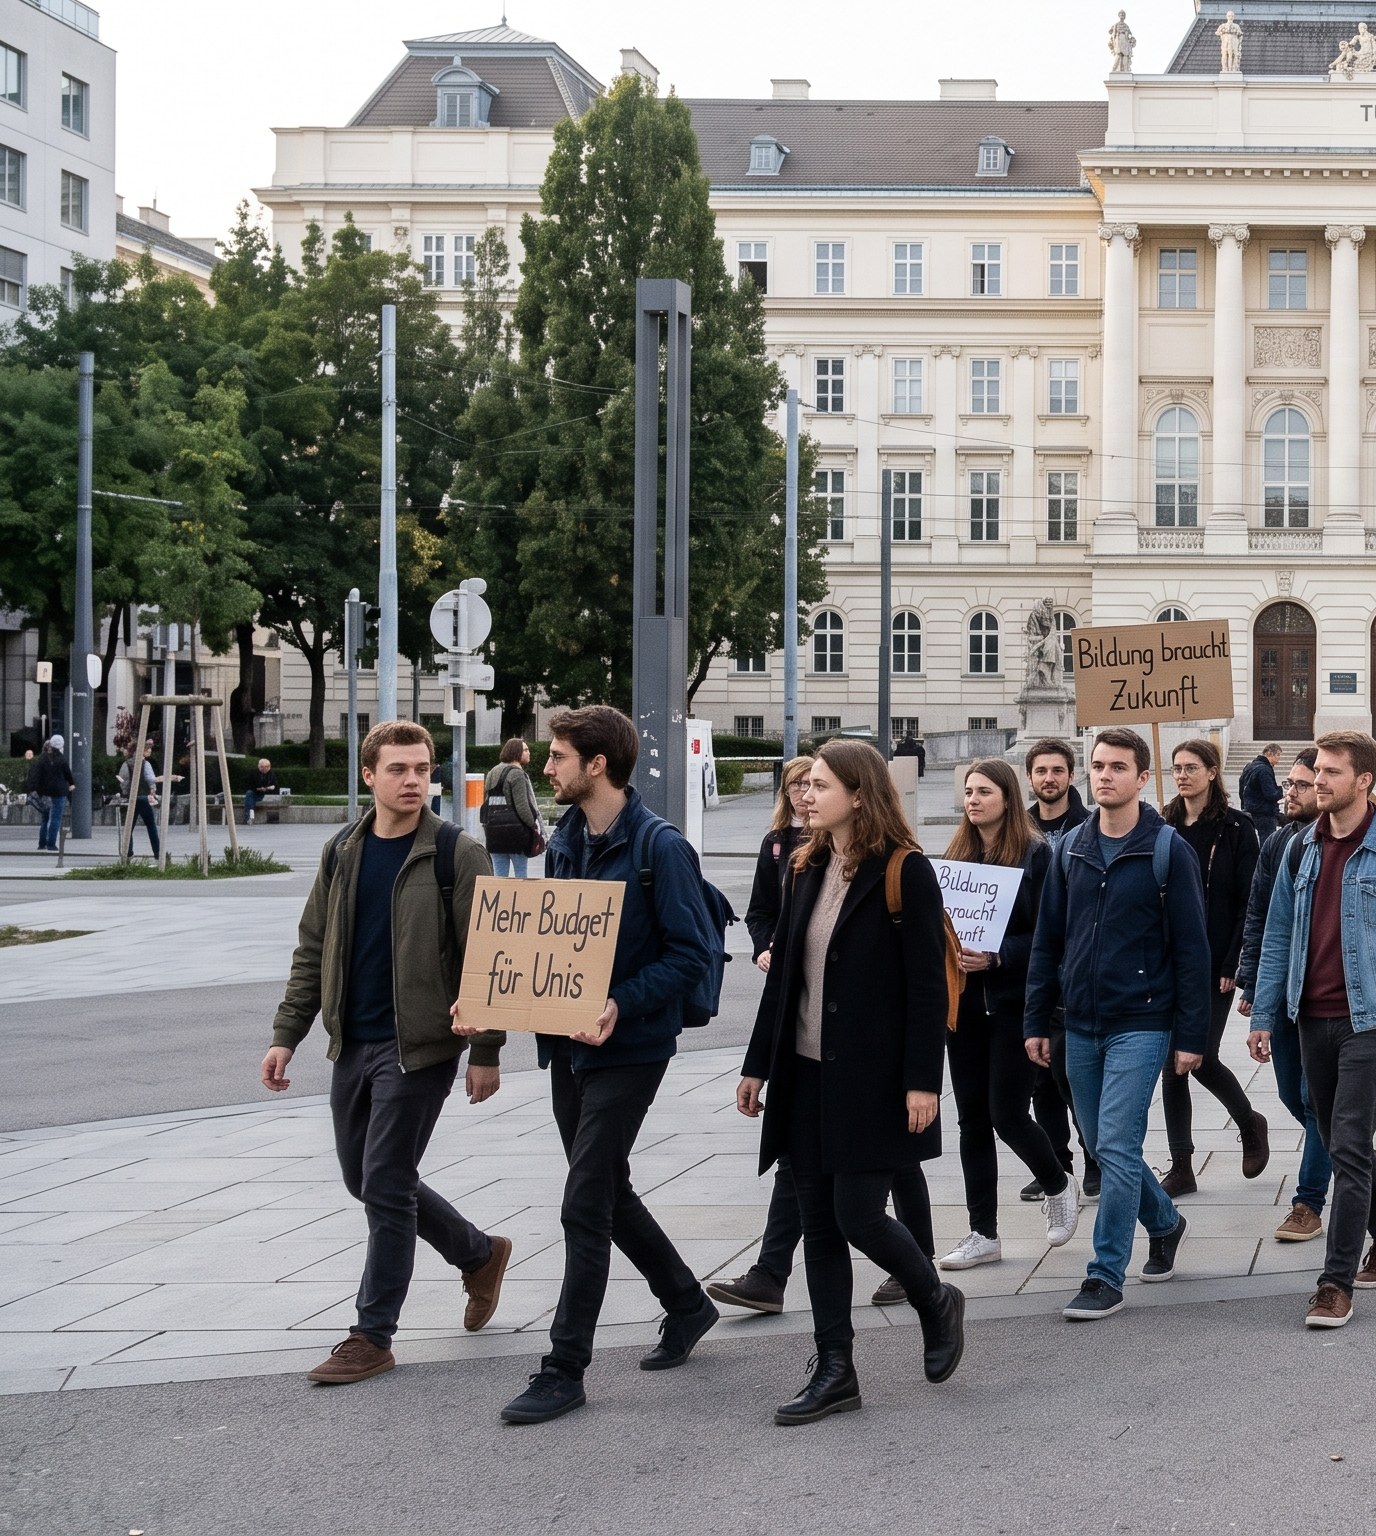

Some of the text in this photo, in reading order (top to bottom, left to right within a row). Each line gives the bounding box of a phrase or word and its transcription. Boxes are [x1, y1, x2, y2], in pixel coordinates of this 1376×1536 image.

[1078, 631, 1229, 676] Bildung braucht
[1109, 675, 1199, 715] Zukunft
[940, 865, 998, 903] Bildung
[476, 889, 615, 953] Mehr Budget
[487, 950, 584, 1006] für Unis
